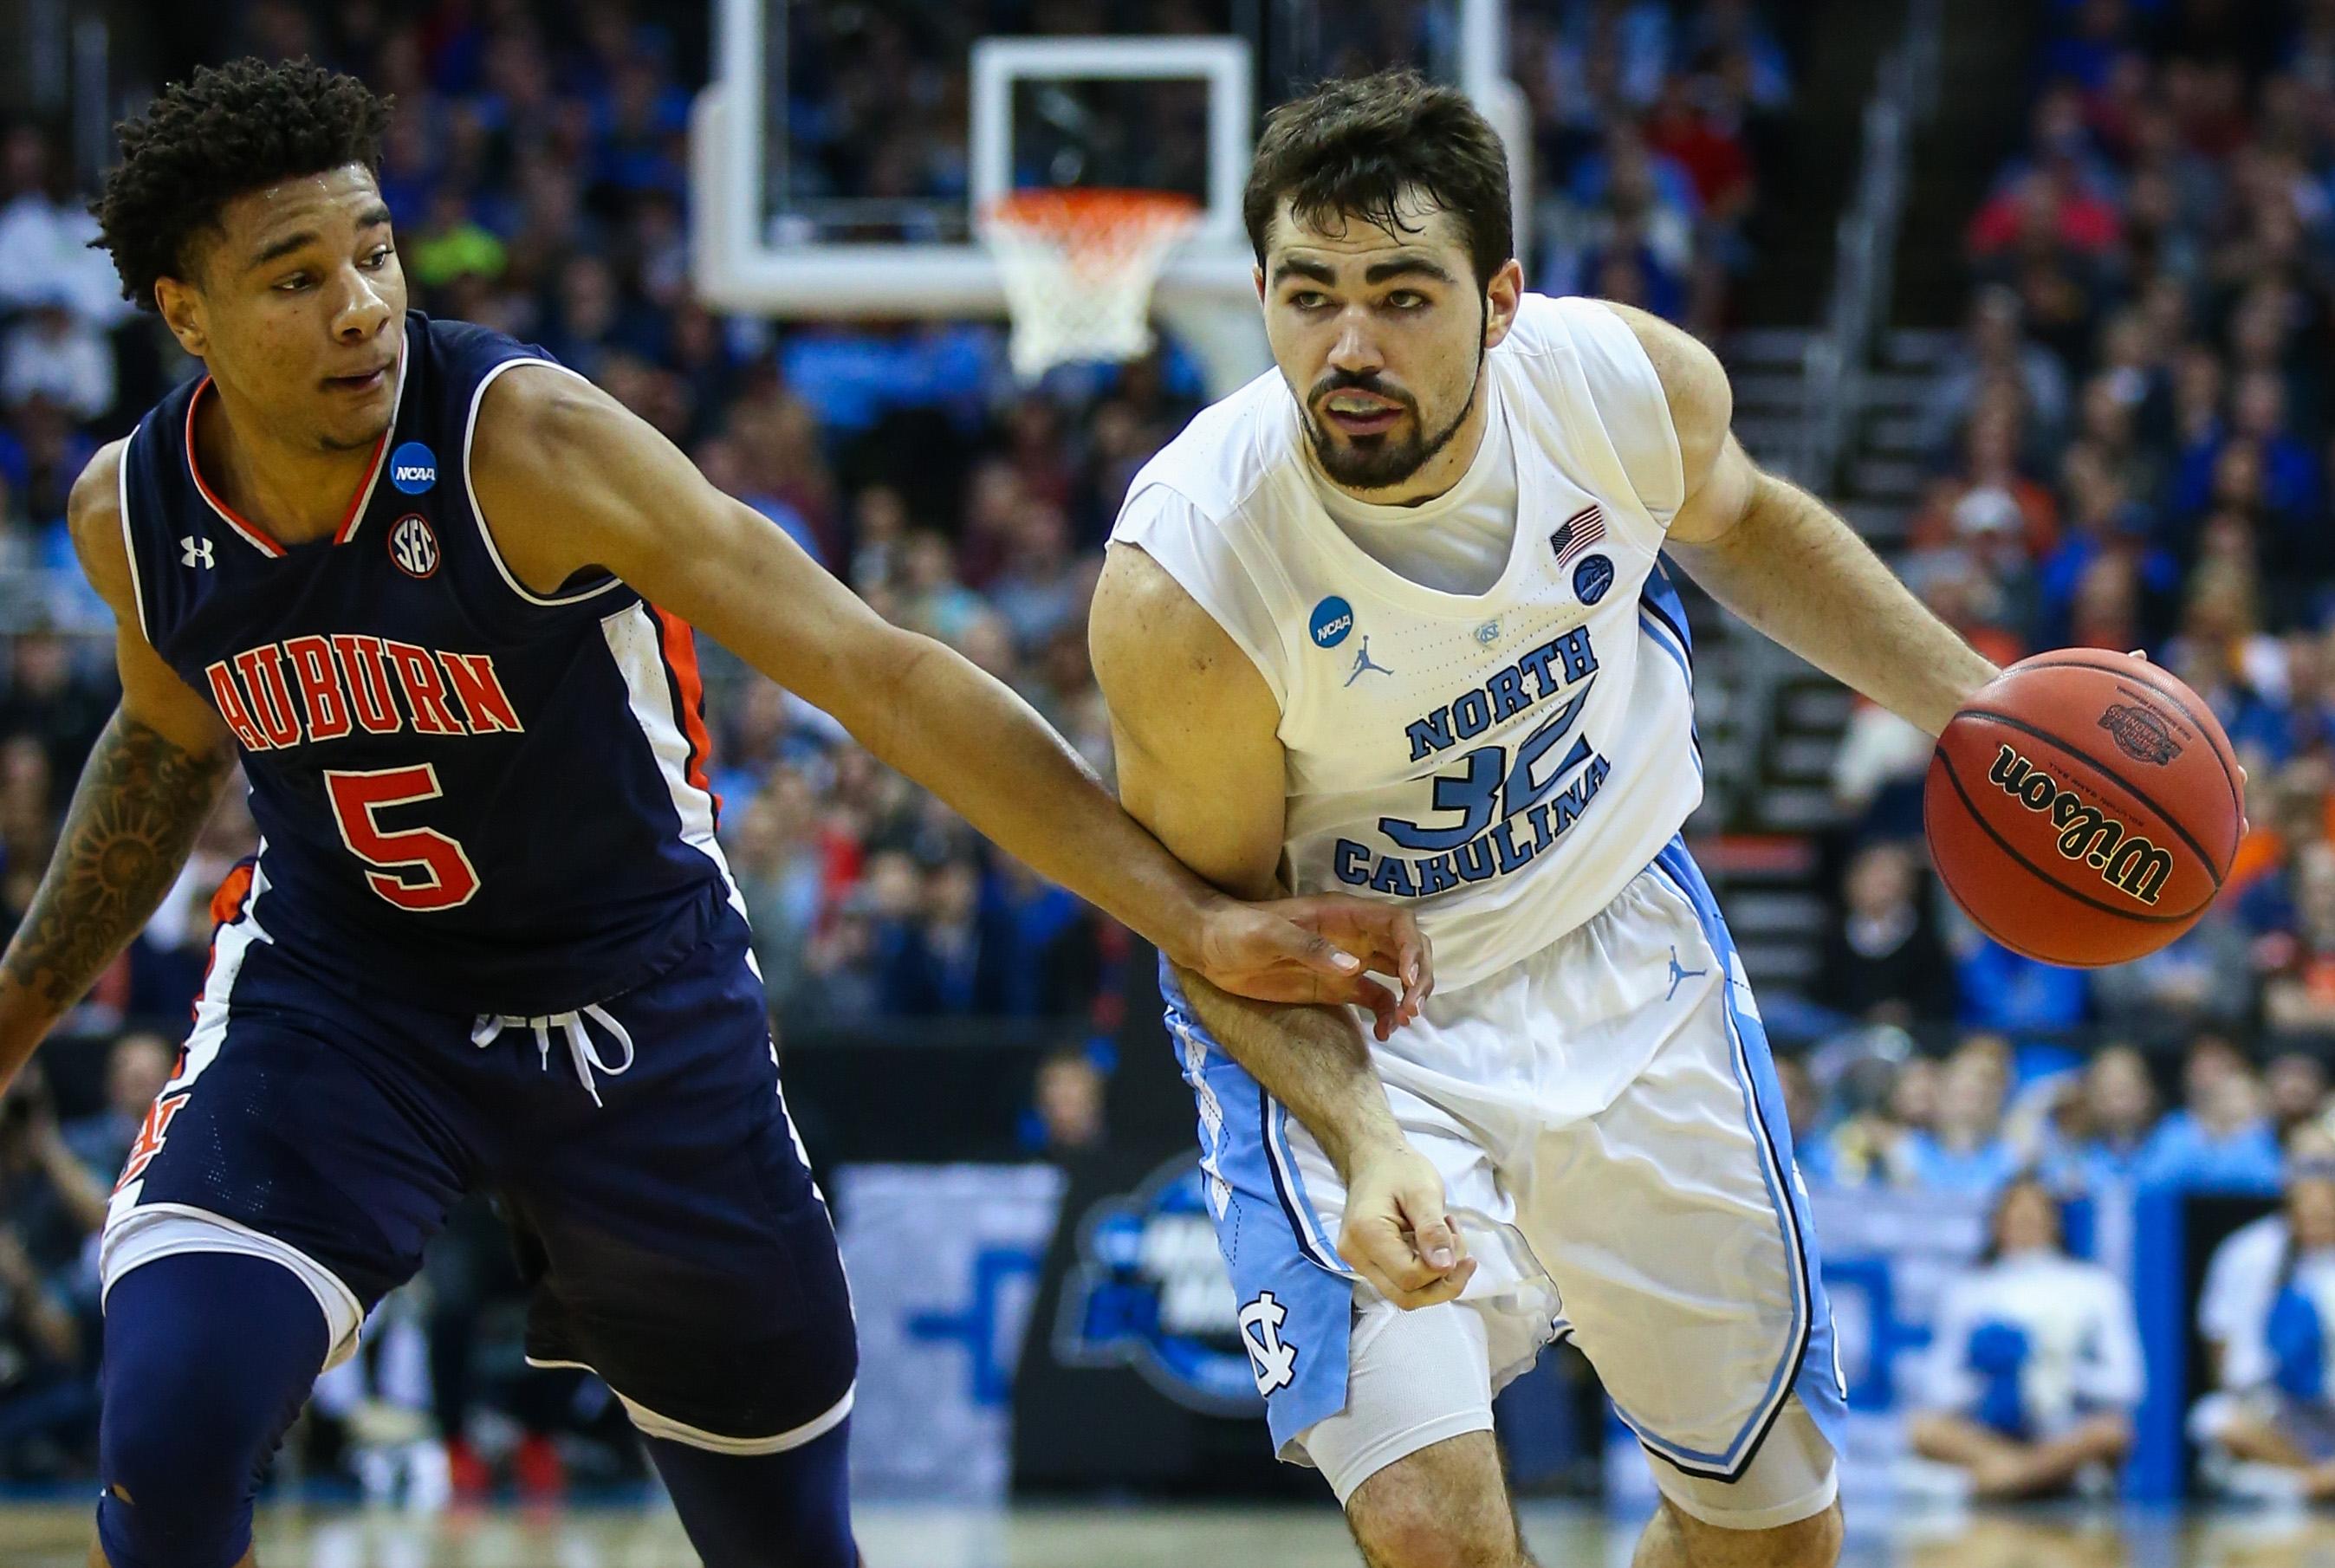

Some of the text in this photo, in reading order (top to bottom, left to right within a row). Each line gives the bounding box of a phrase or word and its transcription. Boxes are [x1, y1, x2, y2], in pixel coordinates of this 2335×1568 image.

[395, 466, 436, 482] NCAA
[394, 519, 436, 573] SEC
[205, 633, 525, 752] AUBURN
[1317, 614, 1352, 642] NCAA
[1404, 625, 1600, 762] NORTH
[1334, 753, 1610, 897] CAROLINA
[1378, 673, 1599, 852] 32
[1988, 743, 2174, 906] Wilson
[323, 762, 482, 912] 5
